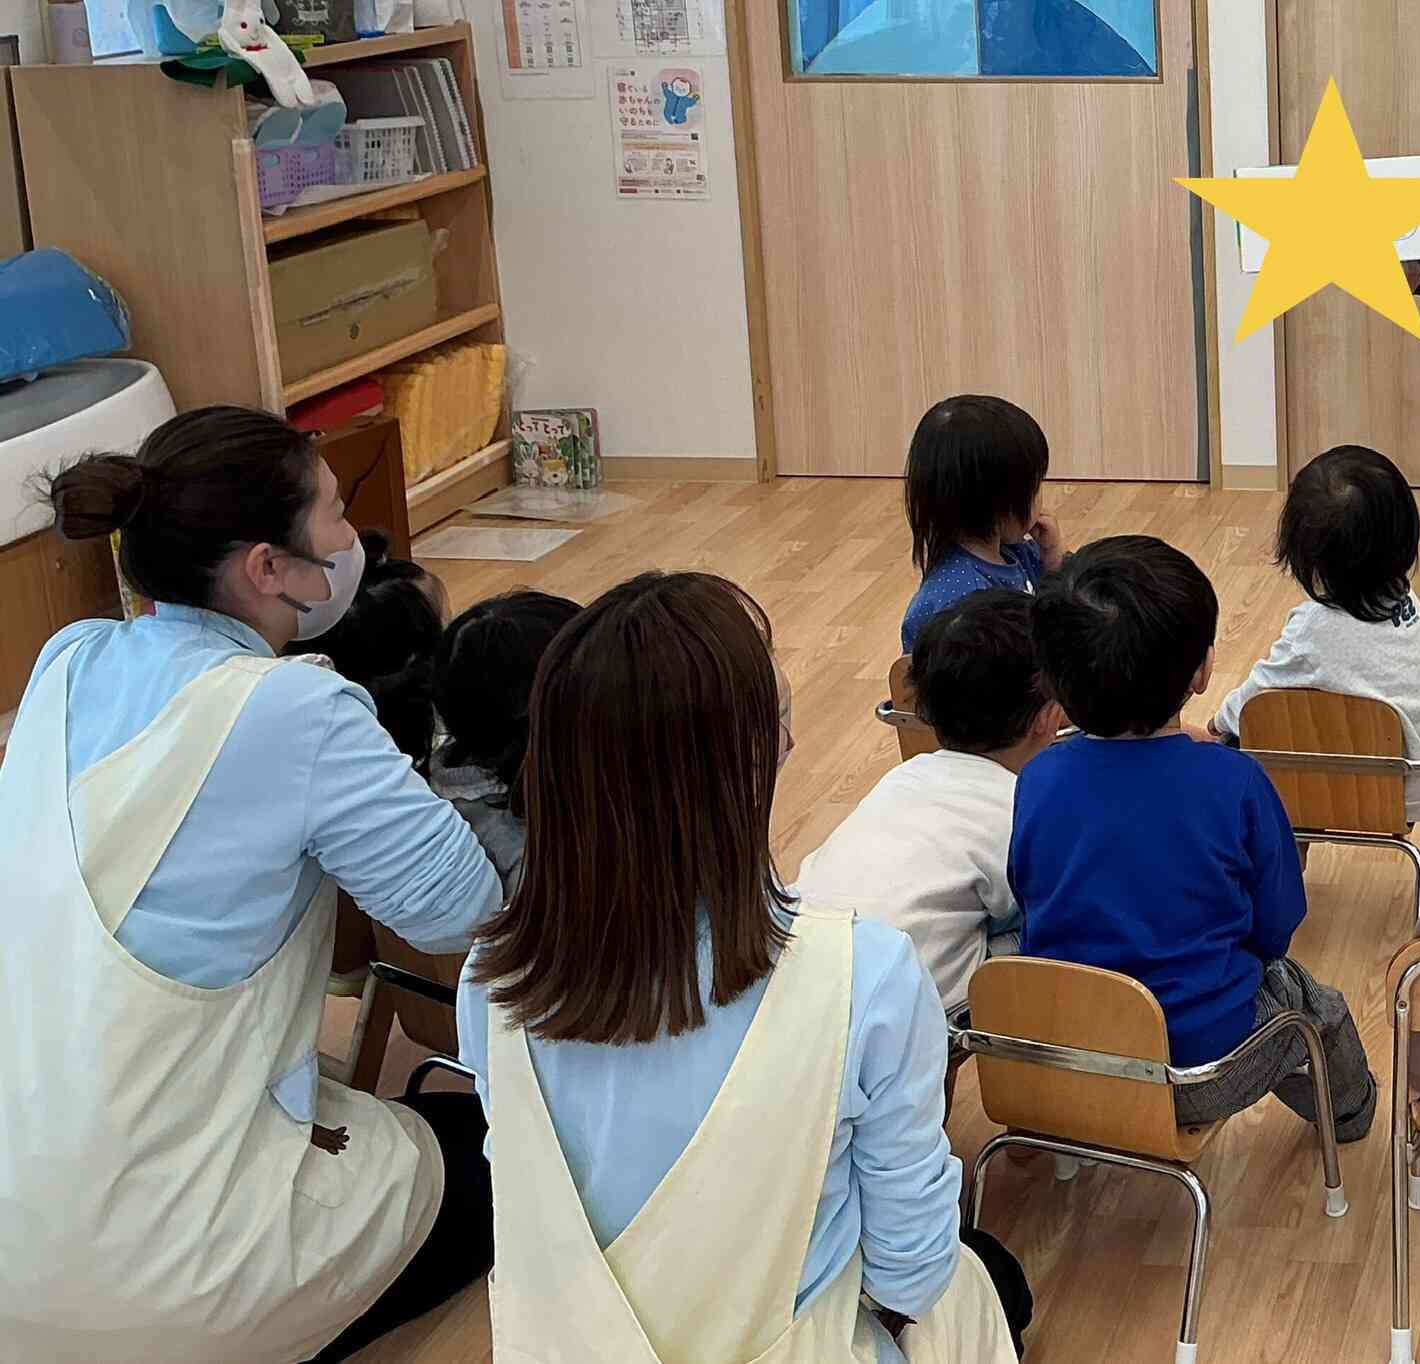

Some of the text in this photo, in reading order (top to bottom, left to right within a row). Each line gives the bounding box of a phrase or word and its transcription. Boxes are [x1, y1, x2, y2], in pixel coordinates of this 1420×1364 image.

[618, 95, 660, 105] 赤ちゃんの
[619, 117, 660, 127] 守るために
